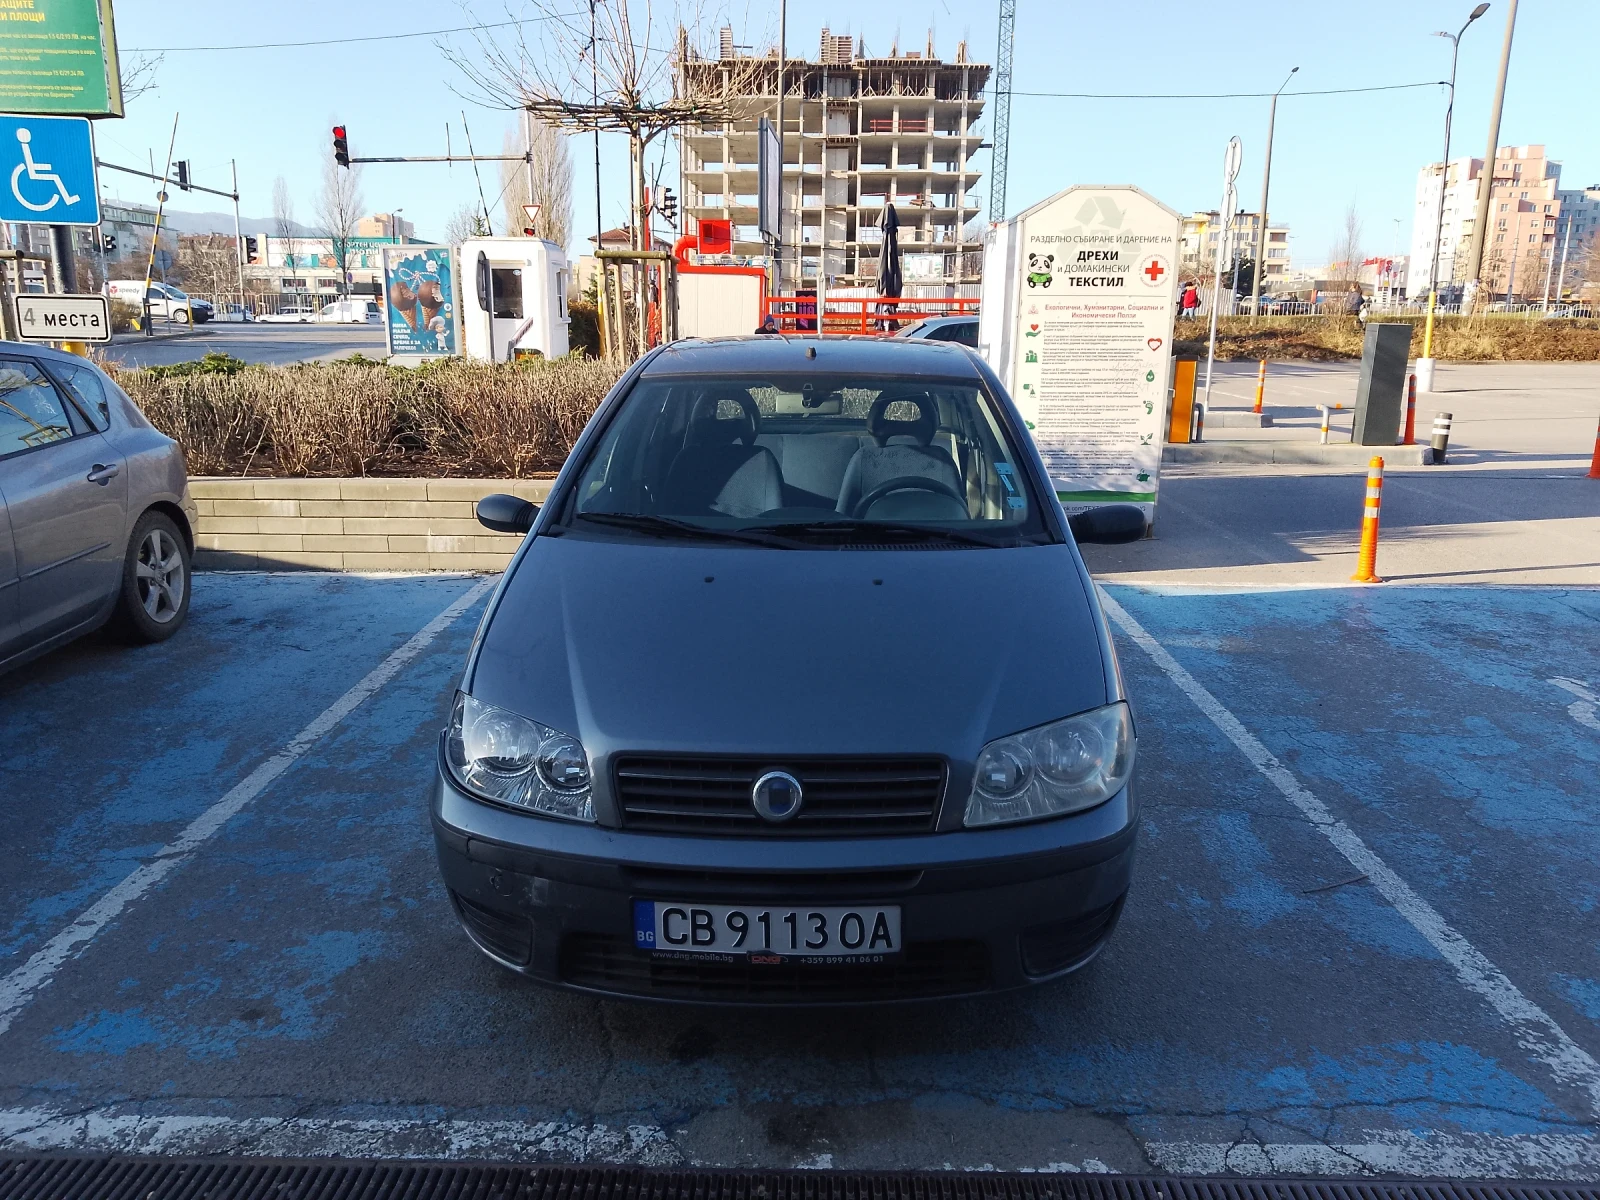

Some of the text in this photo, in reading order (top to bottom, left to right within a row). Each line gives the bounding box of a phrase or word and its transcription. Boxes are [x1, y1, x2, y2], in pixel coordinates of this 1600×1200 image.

[0, 0, 34, 10] АЩИТЕ
[0, 12, 45, 22] И ПЛОЩИ
[1077, 251, 1118, 262] ДРЕХИ
[1064, 265, 1130, 274] ДОМАКИНСКИ
[1069, 277, 1124, 286] ТЕКСТИЛ
[24, 308, 99, 326] 4 места
[662, 907, 893, 949] CB 9113 OA
[637, 931, 654, 942] BG
[652, 951, 734, 963] www.dng.mobile.bg
